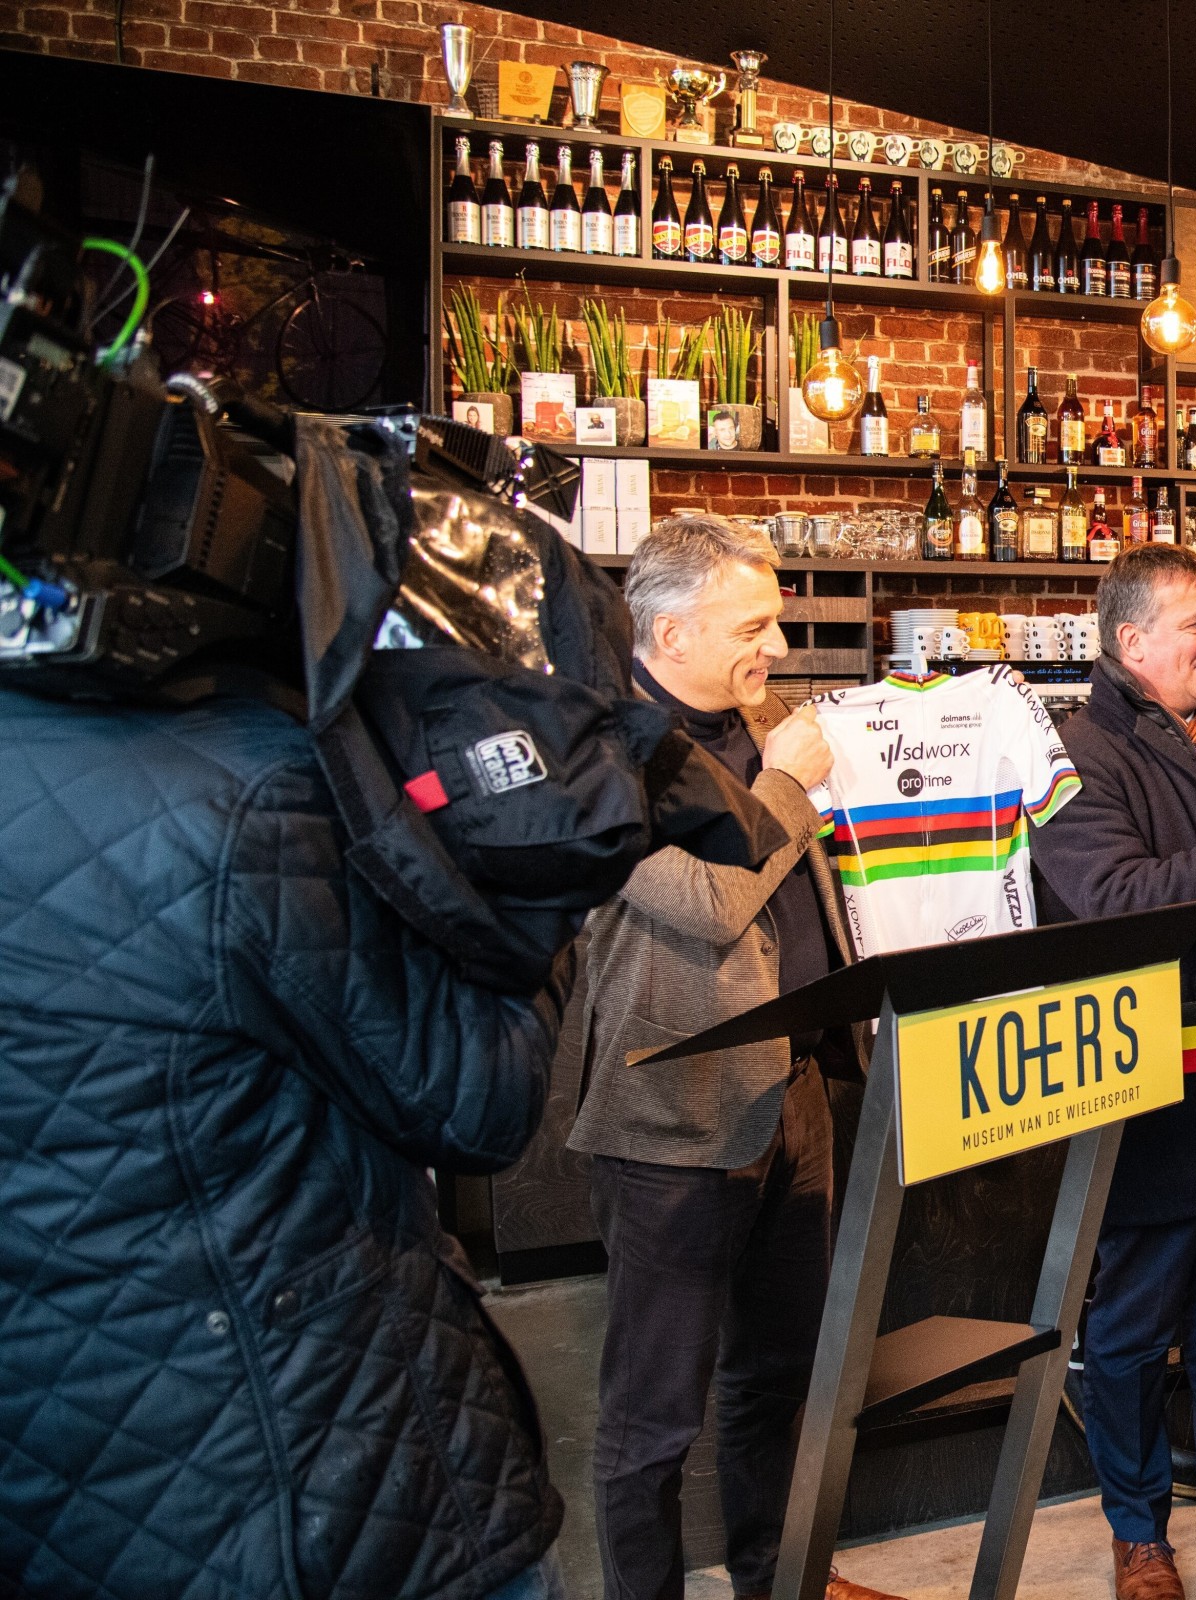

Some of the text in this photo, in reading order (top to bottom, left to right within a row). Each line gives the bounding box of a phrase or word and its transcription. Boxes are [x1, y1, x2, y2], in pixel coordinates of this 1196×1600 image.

[872, 719, 899, 731] UCI
[958, 985, 1139, 1120] KOERS
[962, 1086, 1141, 1151] MUSEUM VAN DE WIELERSPORT
